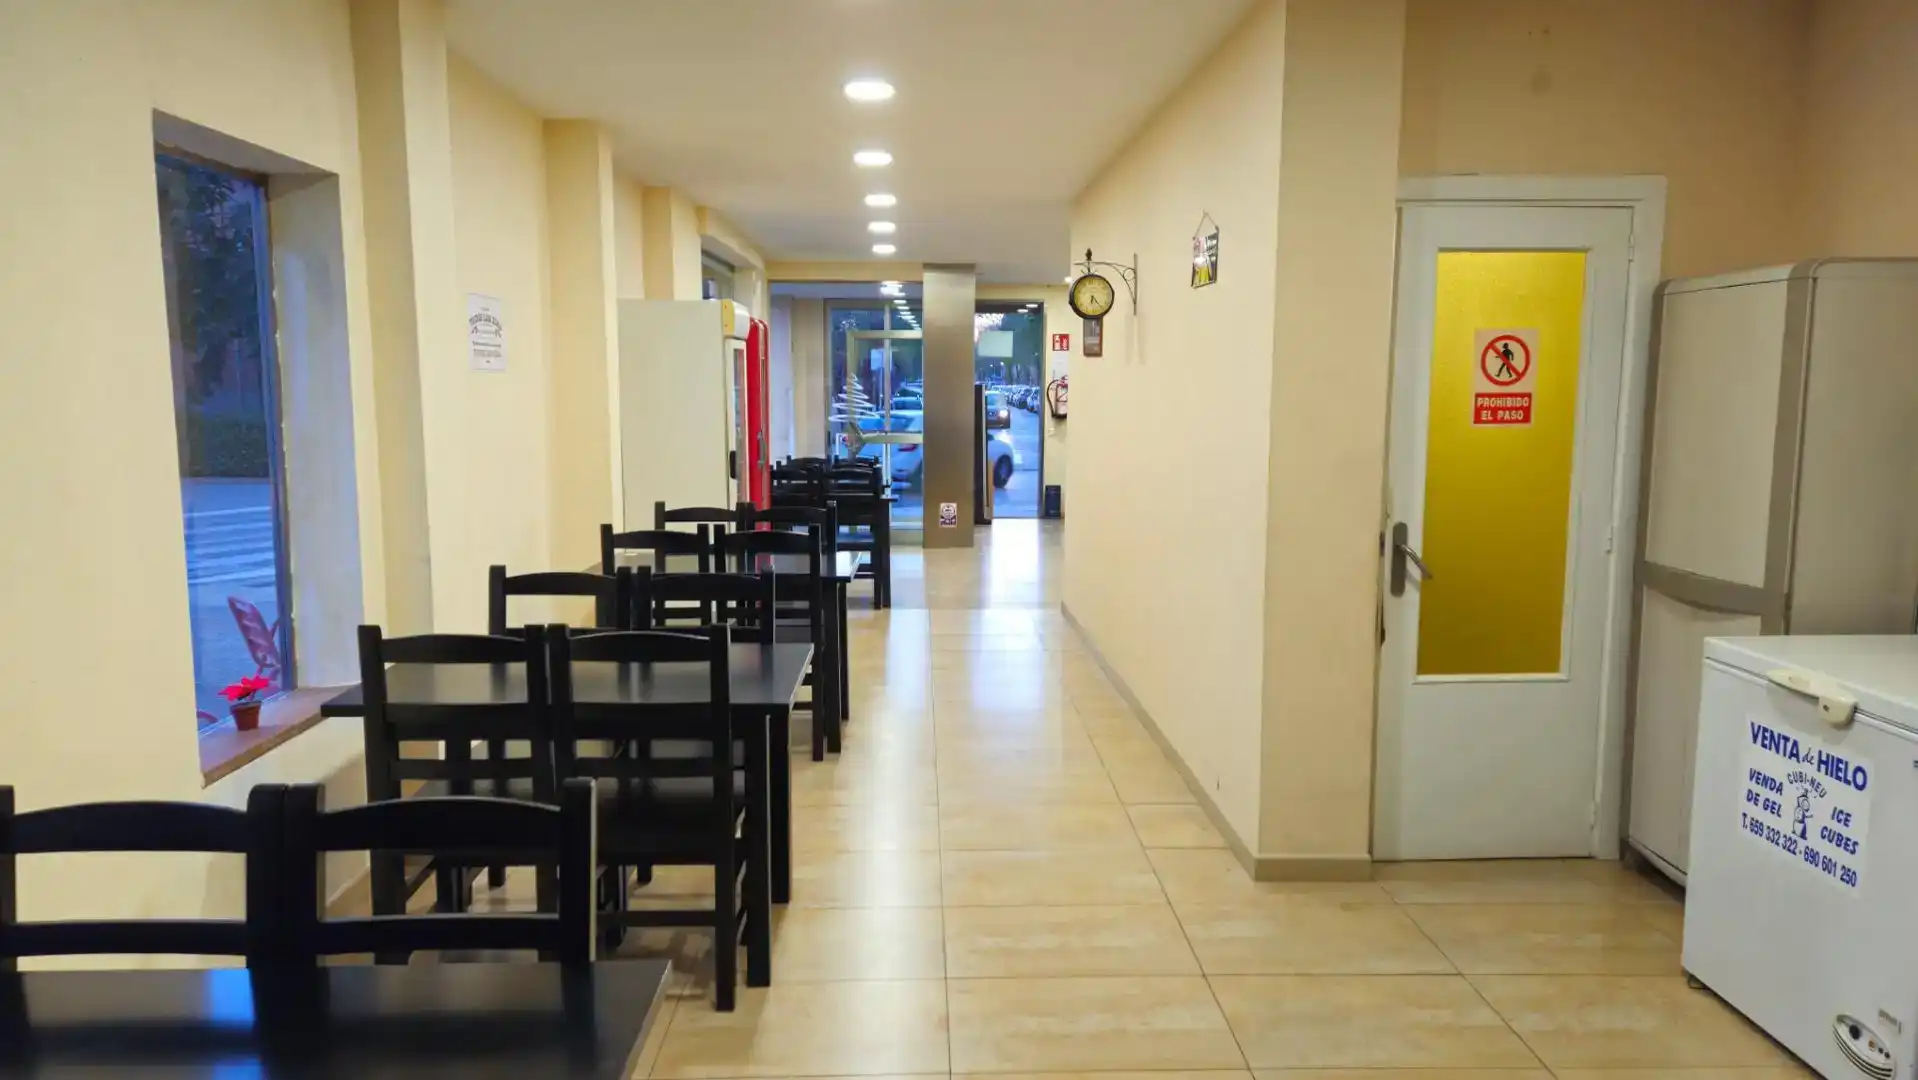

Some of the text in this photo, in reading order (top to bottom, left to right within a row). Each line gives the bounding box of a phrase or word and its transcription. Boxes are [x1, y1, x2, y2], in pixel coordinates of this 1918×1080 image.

[1477, 397, 1529, 407] PROHIBIDO
[1481, 411, 1524, 420] EL PASO
[1750, 722, 1868, 791] VENTA de HIELO
[1749, 768, 1784, 796] VENDA
[1746, 789, 1782, 818] DE GEL
[1831, 807, 1852, 827] ICE
[1742, 812, 1748, 829] T.
[1749, 818, 1764, 837] 659
[1765, 825, 1780, 847] 332
[1782, 834, 1798, 856] 322
[1804, 846, 1820, 867] 690
[1822, 856, 1837, 877] 601
[1840, 865, 1857, 888] 250
[1820, 826, 1859, 855] CUBES
